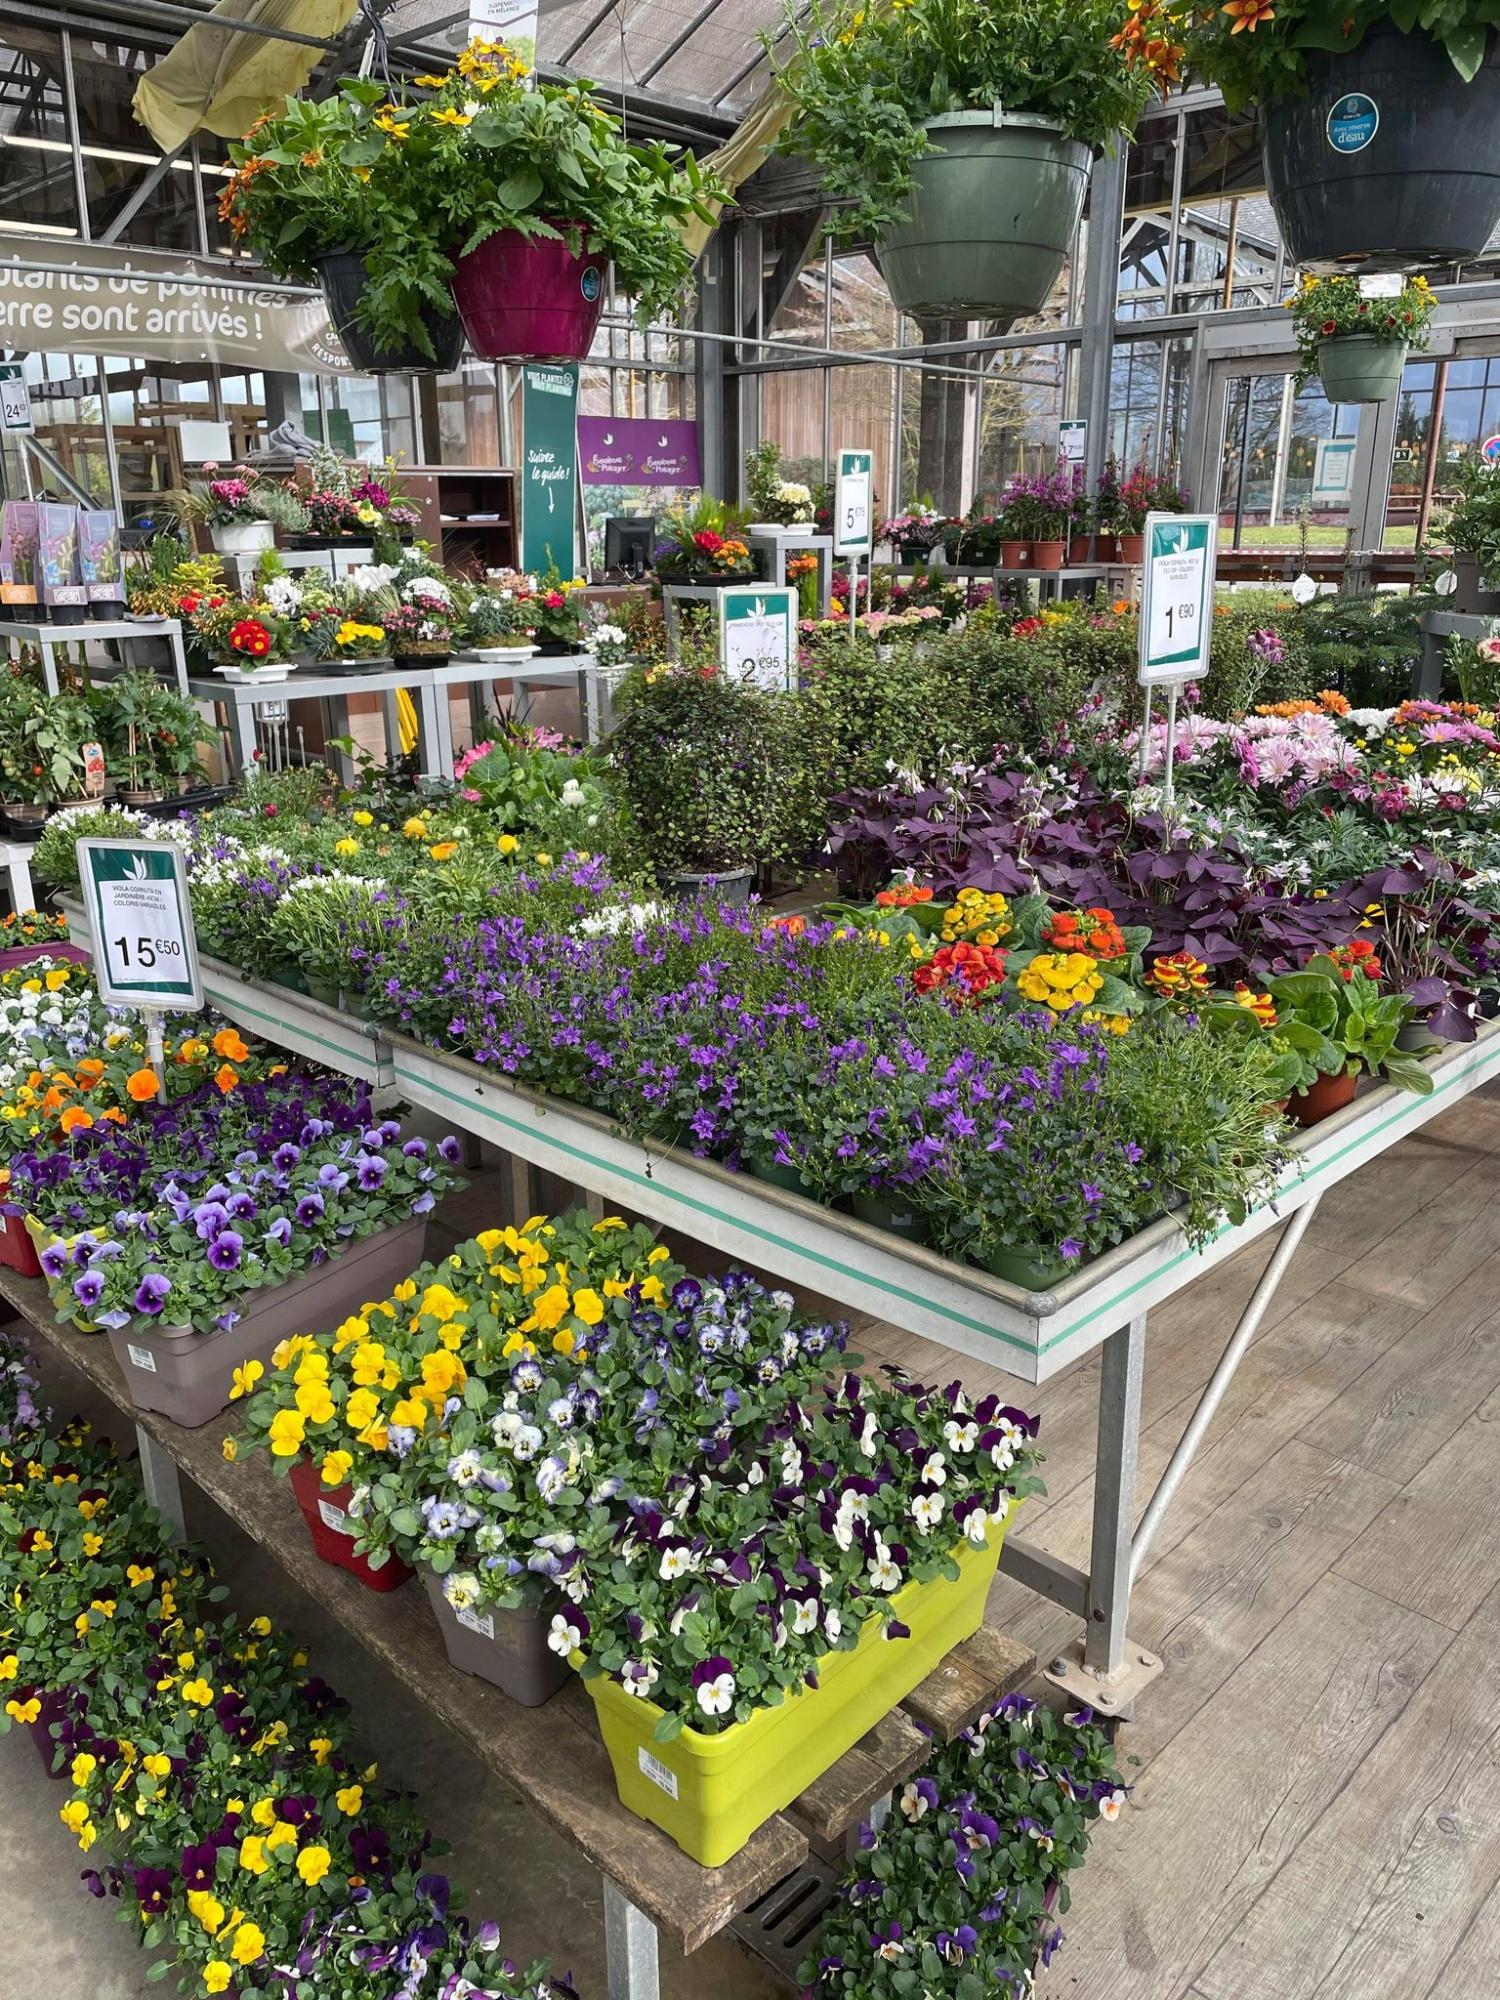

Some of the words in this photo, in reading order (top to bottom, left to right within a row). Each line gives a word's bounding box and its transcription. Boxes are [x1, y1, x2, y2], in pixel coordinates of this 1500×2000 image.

[1338, 131, 1365, 144] d'eau
[62, 302, 139, 332] sont
[145, 303, 249, 339] arrivés
[311, 342, 353, 367] RESPON
[528, 449, 555, 464] Suivez
[531, 465, 541, 480] le
[130, 886, 154, 894] CORNUTA
